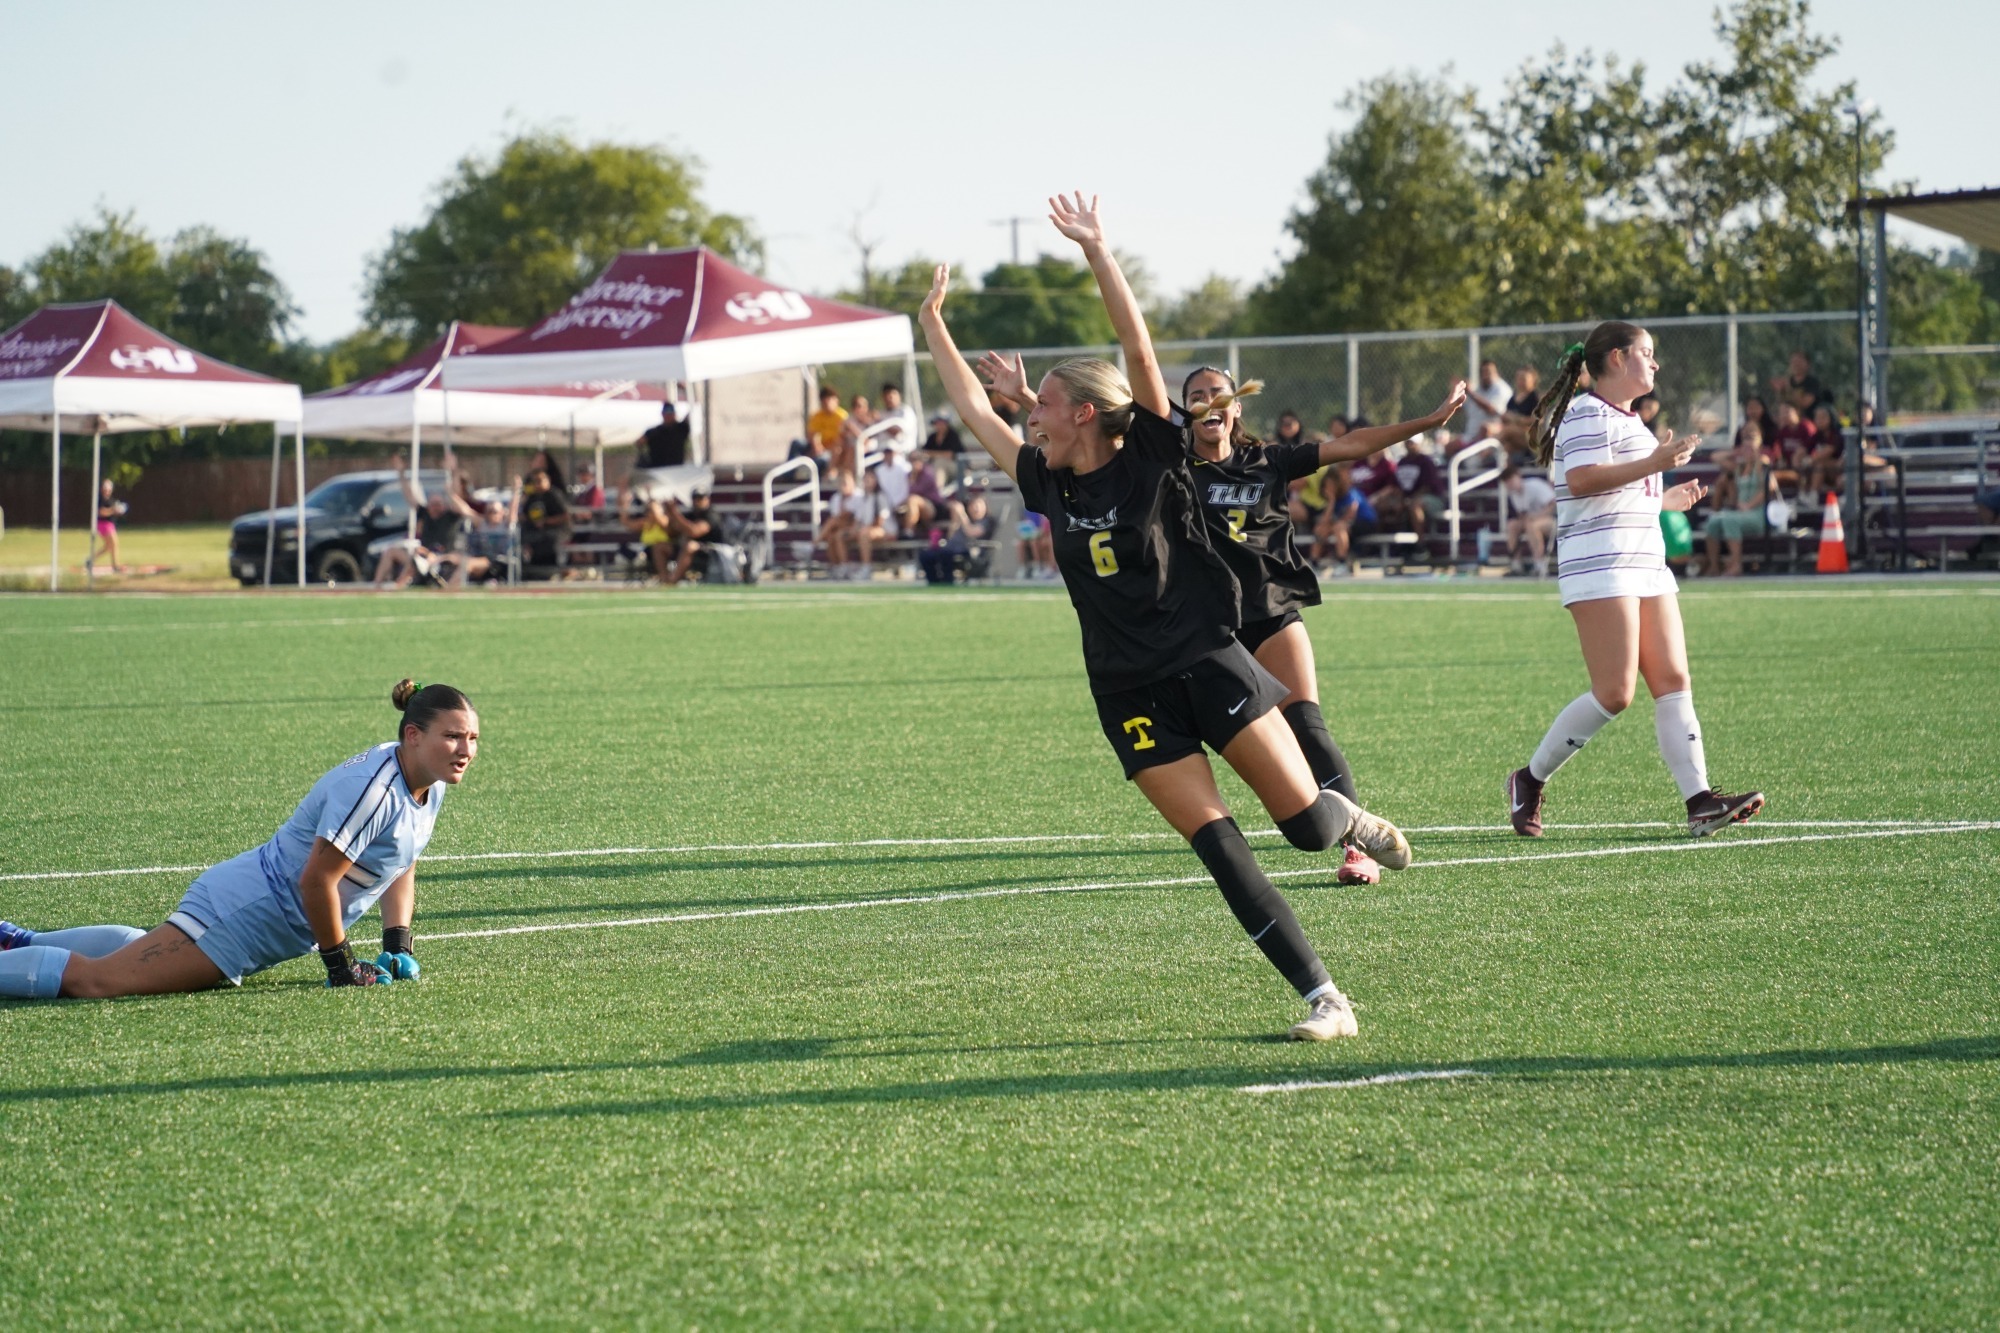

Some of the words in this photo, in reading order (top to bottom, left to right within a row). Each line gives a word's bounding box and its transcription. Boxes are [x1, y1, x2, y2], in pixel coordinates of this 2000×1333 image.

[1208, 483, 1265, 505] TLU
[1227, 508, 1248, 543] 2
[1089, 530, 1120, 578] 6
[1122, 716, 1156, 751] T
